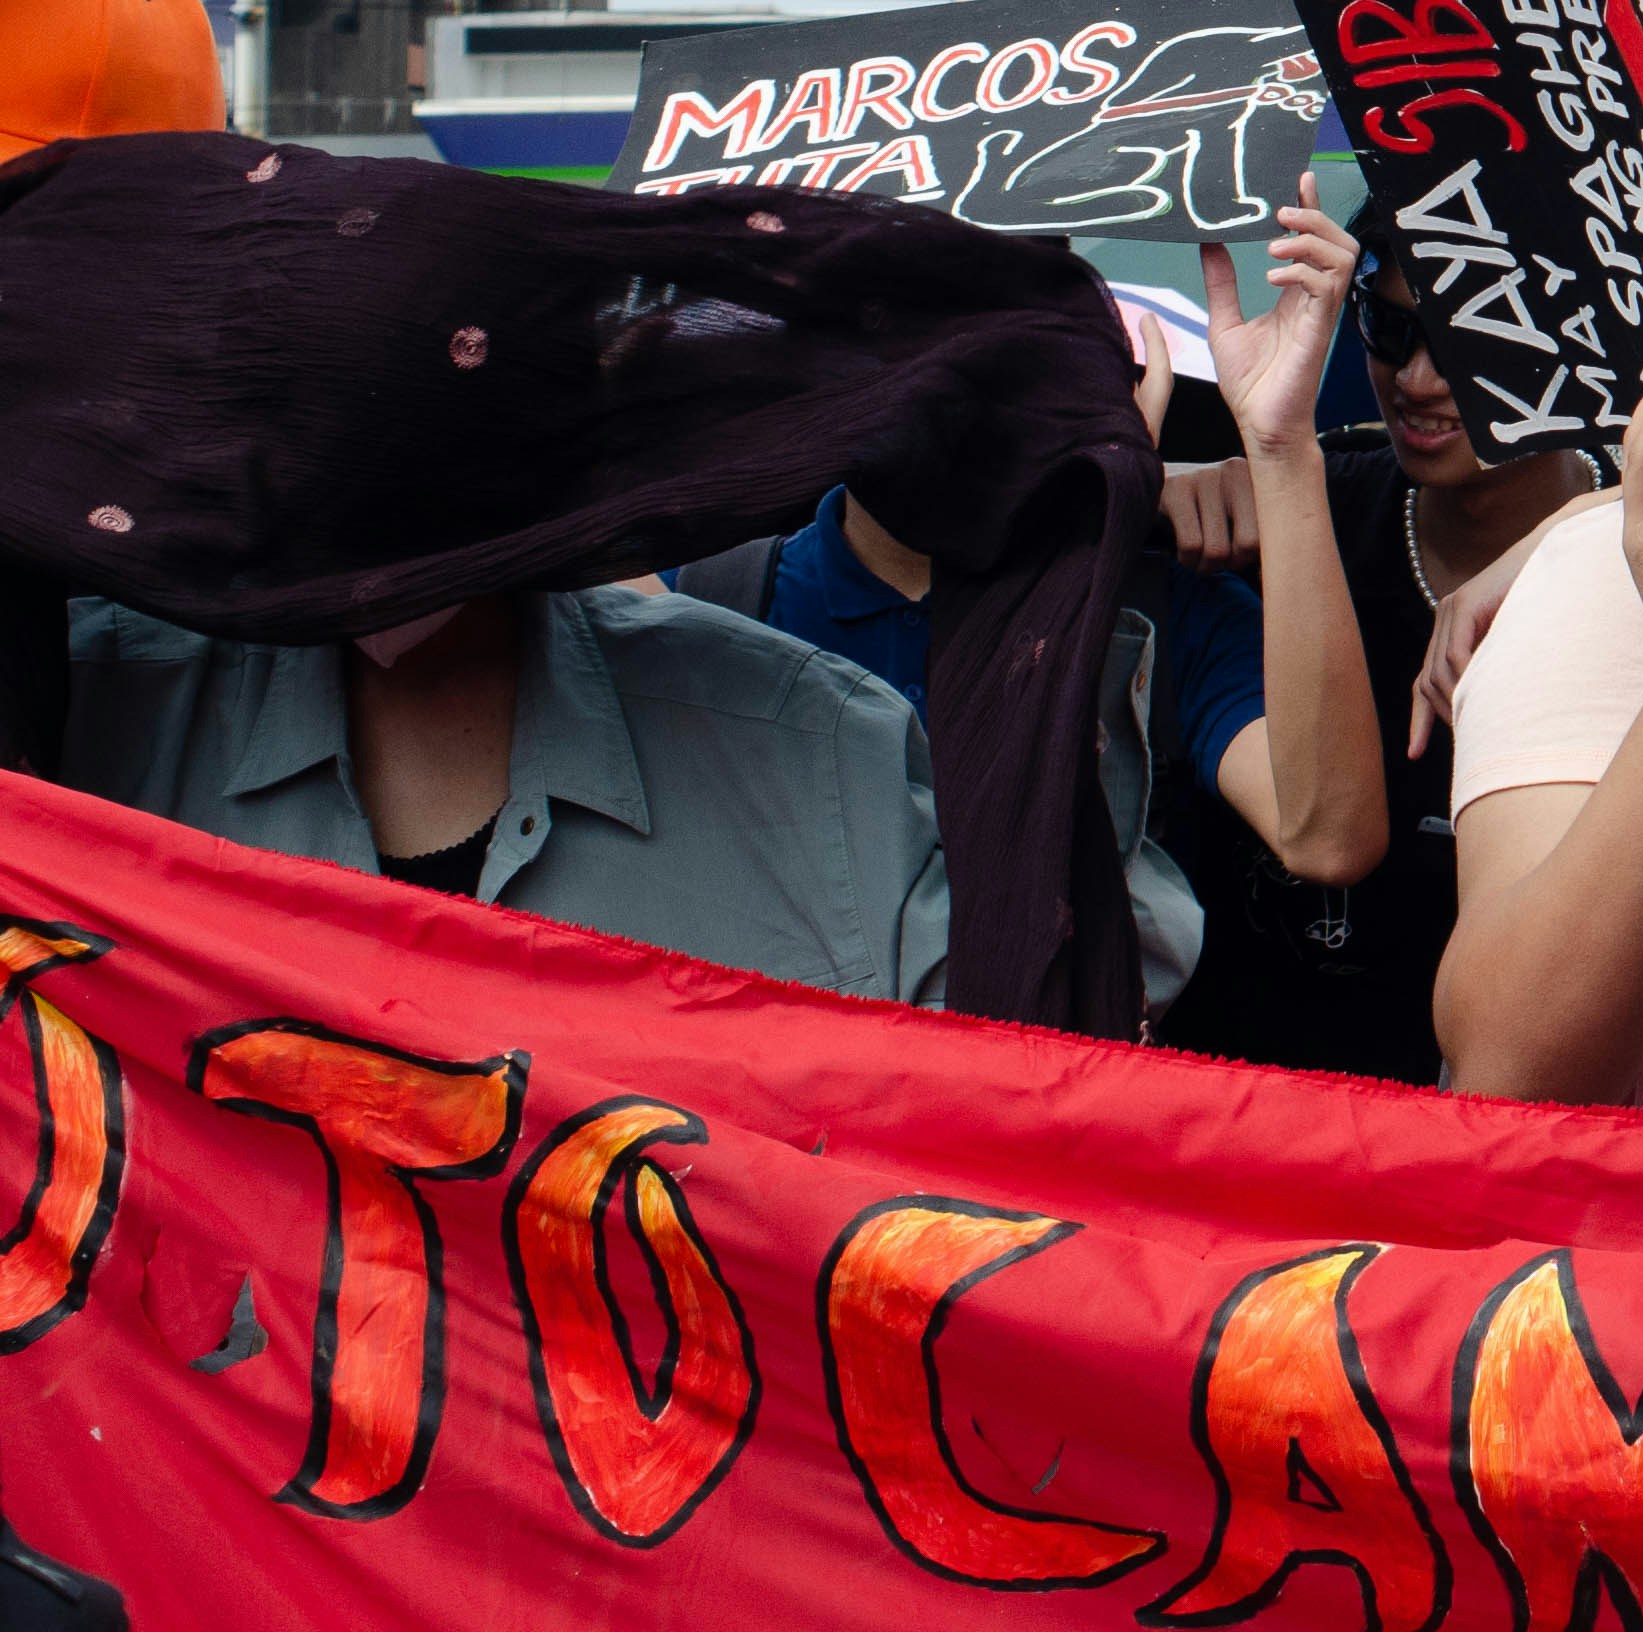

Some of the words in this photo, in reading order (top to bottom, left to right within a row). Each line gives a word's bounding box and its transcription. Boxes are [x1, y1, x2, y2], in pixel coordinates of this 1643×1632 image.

[642, 21, 1137, 172] MARCOS
[1396, 158, 1586, 444] KAYA
[1529, 251, 1634, 428] MAY
[187, 1015, 763, 1550] TO
